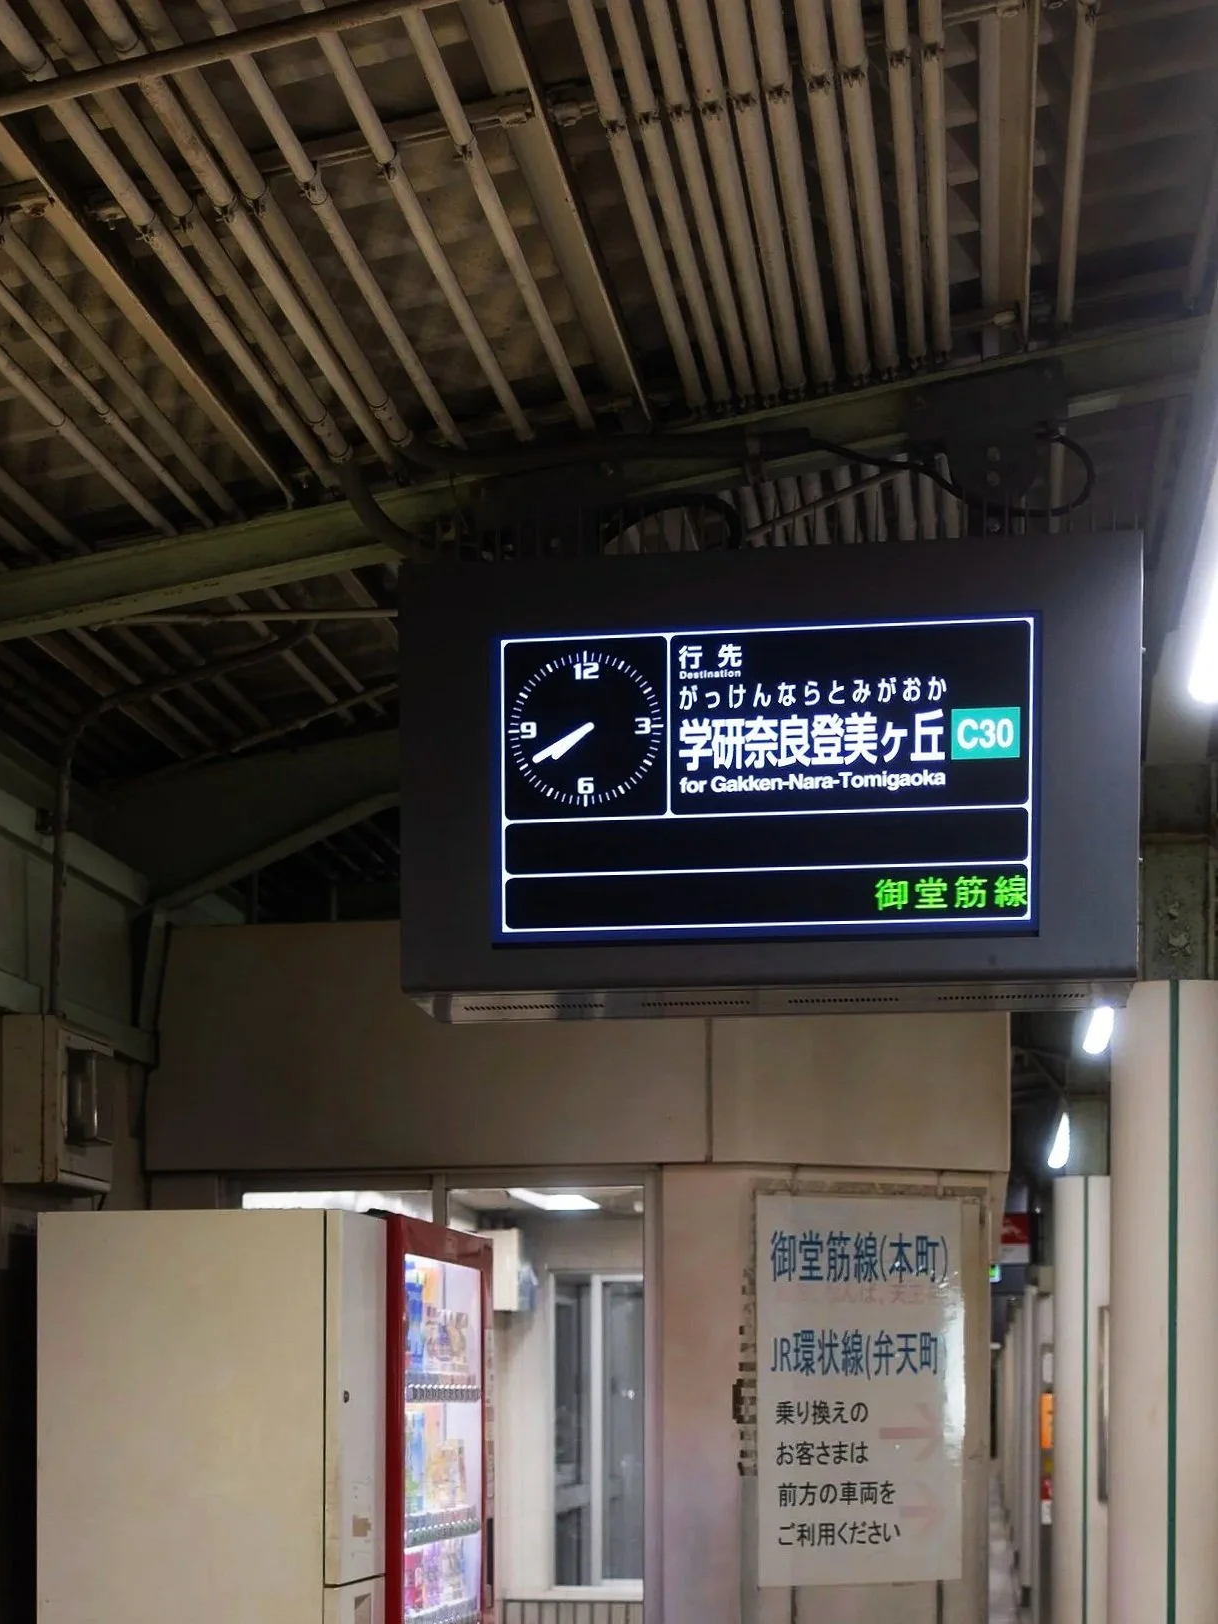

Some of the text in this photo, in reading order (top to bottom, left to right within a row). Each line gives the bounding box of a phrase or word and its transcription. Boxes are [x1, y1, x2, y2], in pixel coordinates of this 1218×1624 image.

[573, 662, 600, 680] 12
[679, 668, 742, 680] Destination
[678, 676, 947, 711] がっけんならとみがおか
[520, 722, 537, 739] 9
[635, 717, 651, 734] 3
[955, 718, 1015, 750] C30
[678, 708, 946, 771] 学研奈良登美ヶ丘
[576, 777, 594, 795] 6
[680, 768, 946, 794] for Gakken-Nara-Tomigaoka
[874, 875, 1028, 911] 御堂筋線
[770, 1229, 949, 1284] 御堂筋線(本町)
[775, 1400, 869, 1426] 乗り換えの
[775, 1440, 869, 1466] お客さまは
[778, 1480, 897, 1507] 前方の車両を
[778, 1520, 901, 1547] ご利用ください
